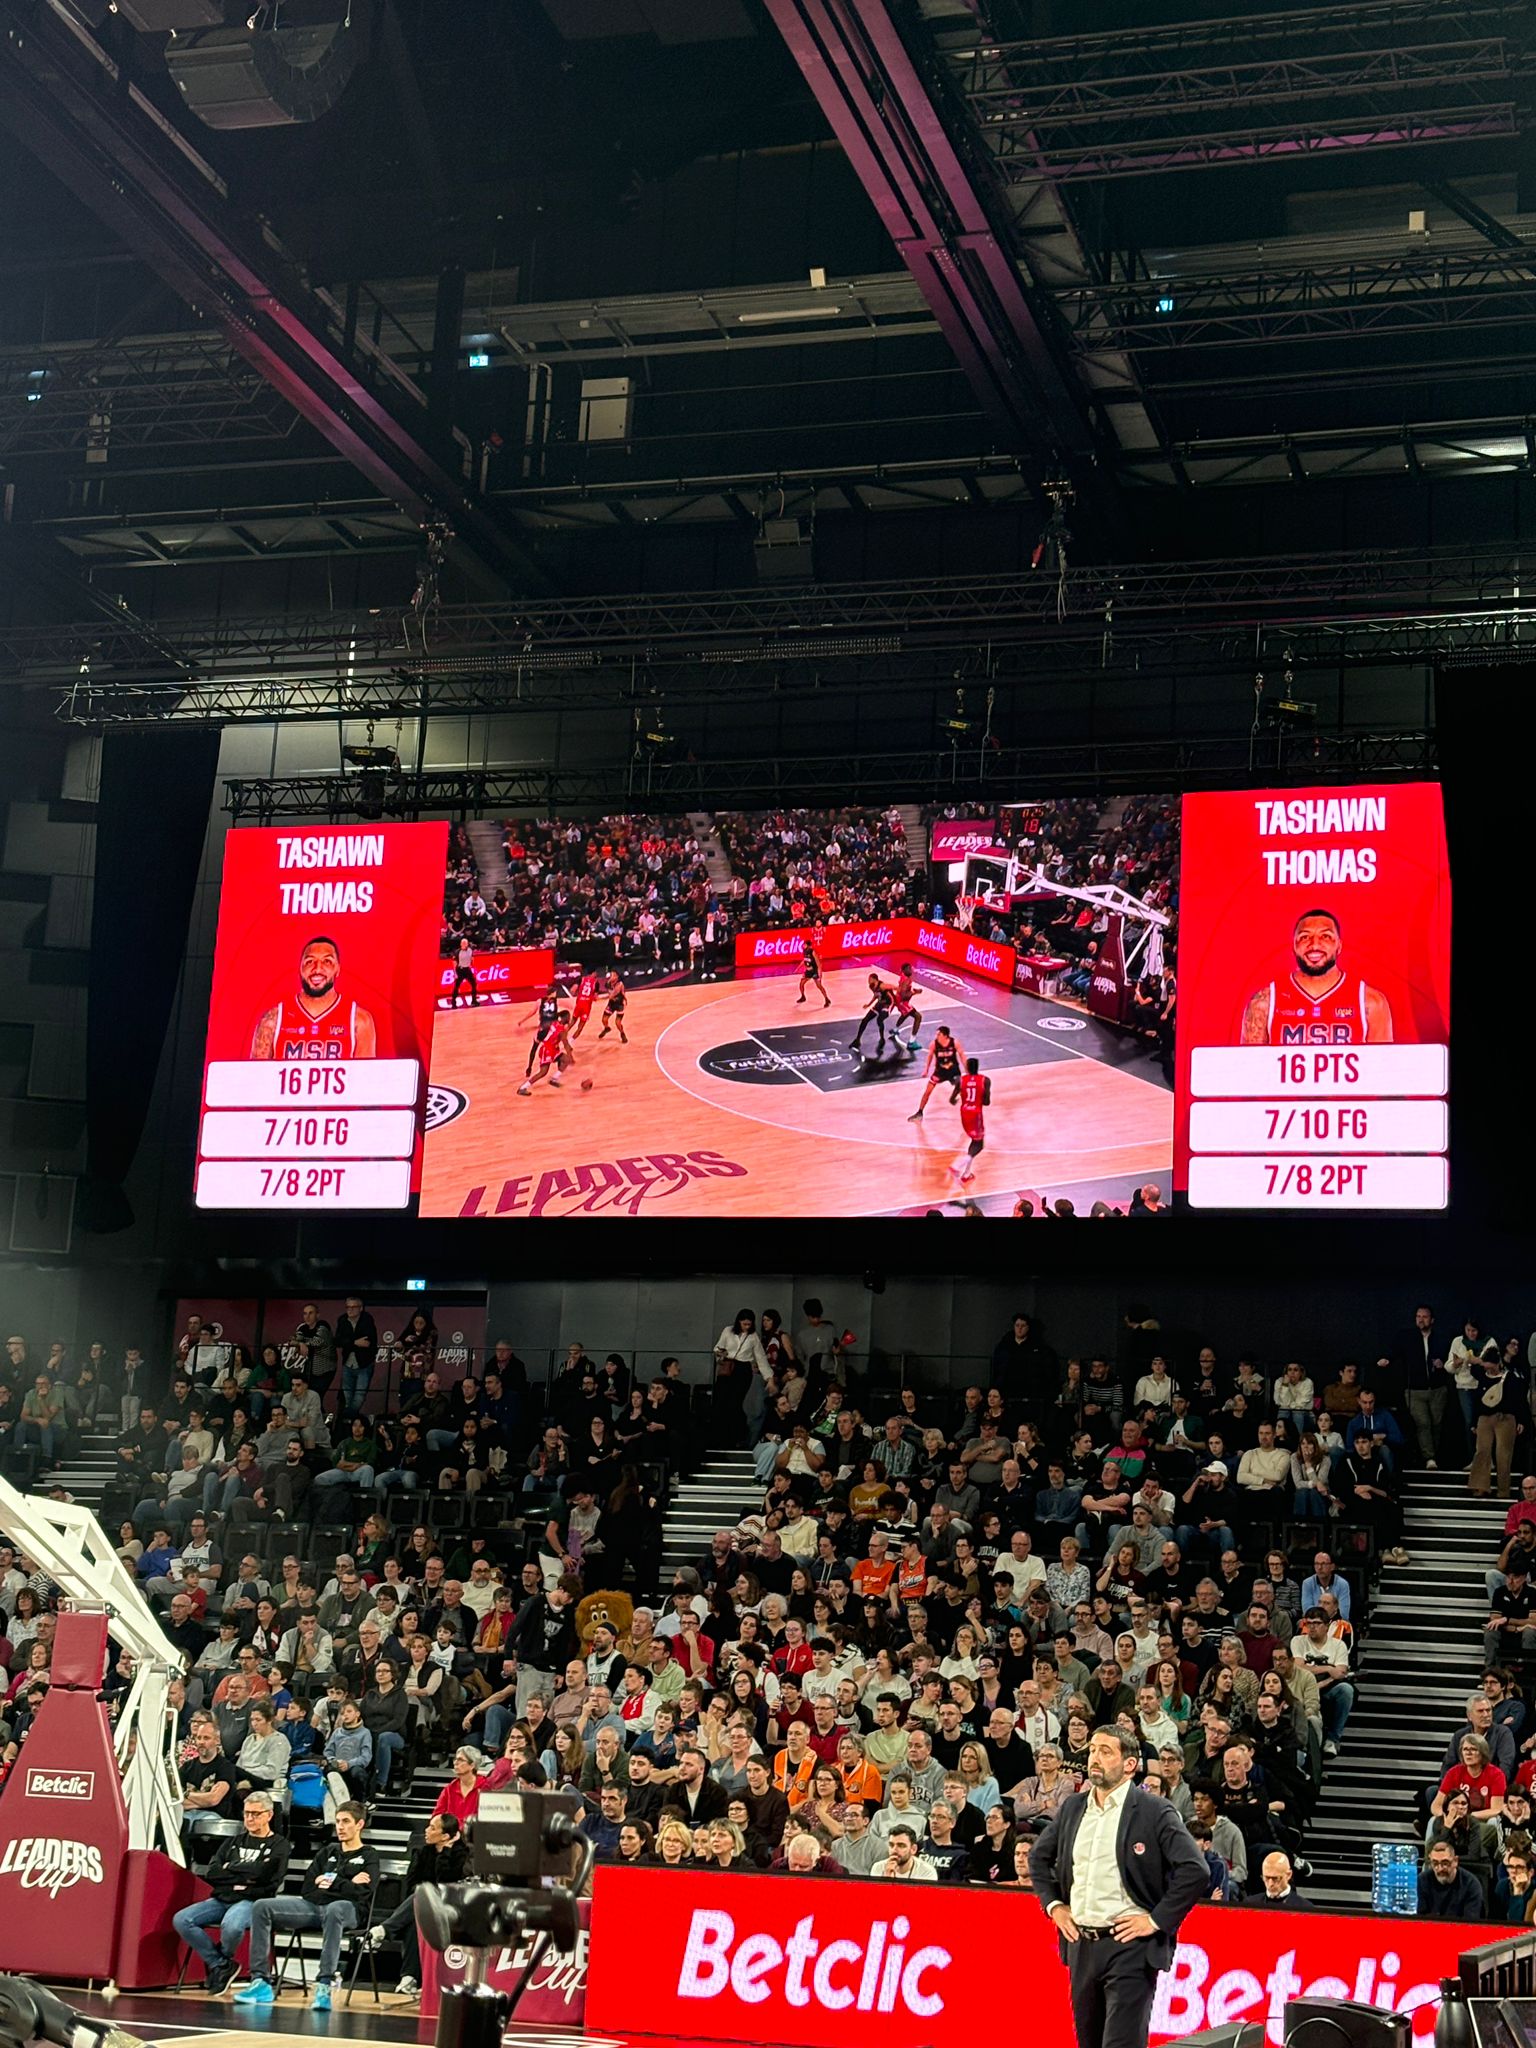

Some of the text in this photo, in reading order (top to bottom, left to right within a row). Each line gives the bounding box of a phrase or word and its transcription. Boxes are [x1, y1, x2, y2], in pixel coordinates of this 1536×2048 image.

[1255, 797, 1386, 836] TASHAWN
[276, 835, 384, 869] TASHAWN
[1262, 848, 1377, 885] THOMAS
[280, 881, 373, 915] THOMAS
[842, 928, 893, 949] Betclic
[917, 928, 947, 953] Betclic
[966, 943, 1001, 972] Betclic
[441, 963, 510, 985] Bclic
[278, 1067, 346, 1095] 16 PTS
[1277, 1053, 1359, 1083] 16 PTS
[264, 1118, 349, 1147] 7/10 FG
[1265, 1108, 1367, 1140] 7/10 FG
[260, 1168, 346, 1197] 7/8 2PT
[459, 1150, 748, 1217] LEADERS
[1264, 1164, 1367, 1195] 7/8 2PT
[31, 1774, 88, 1795] Betclic
[0, 1838, 104, 1884] LEADERS
[20, 1857, 81, 1899] Cup
[677, 1909, 952, 2017] Betclic
